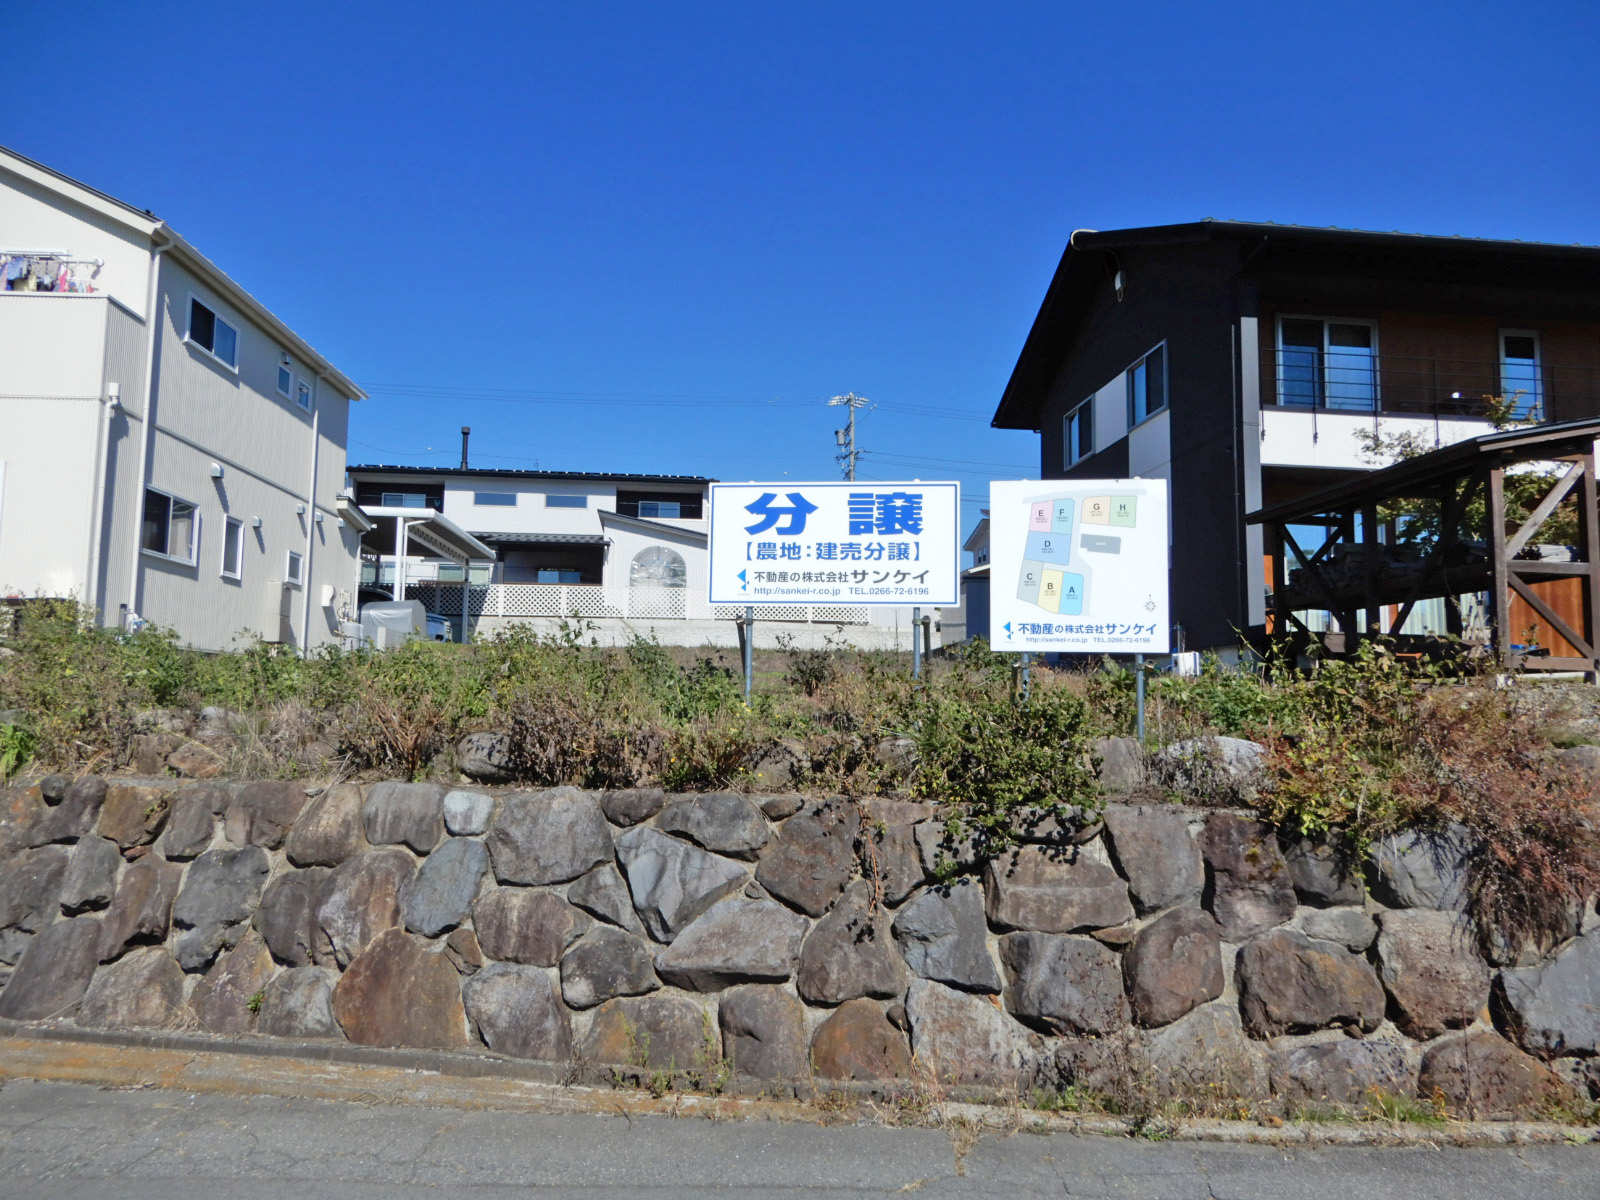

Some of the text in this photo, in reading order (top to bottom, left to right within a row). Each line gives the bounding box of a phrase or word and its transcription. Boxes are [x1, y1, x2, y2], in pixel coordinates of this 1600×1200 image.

[1038, 509, 1044, 517] E
[1059, 508, 1065, 516] F
[1044, 540, 1051, 548] D
[754, 569, 930, 584] 不動産の株式会社サンケイ
[1047, 582, 1054, 590] B
[1068, 586, 1075, 594] A
[754, 587, 930, 596] http://sankei-r.co.jp TEL.0266-72-6196
[1018, 622, 1157, 635] 不動産の株式会社サンケイ
[1025, 636, 1088, 644] http://sankei-r.co.jp
